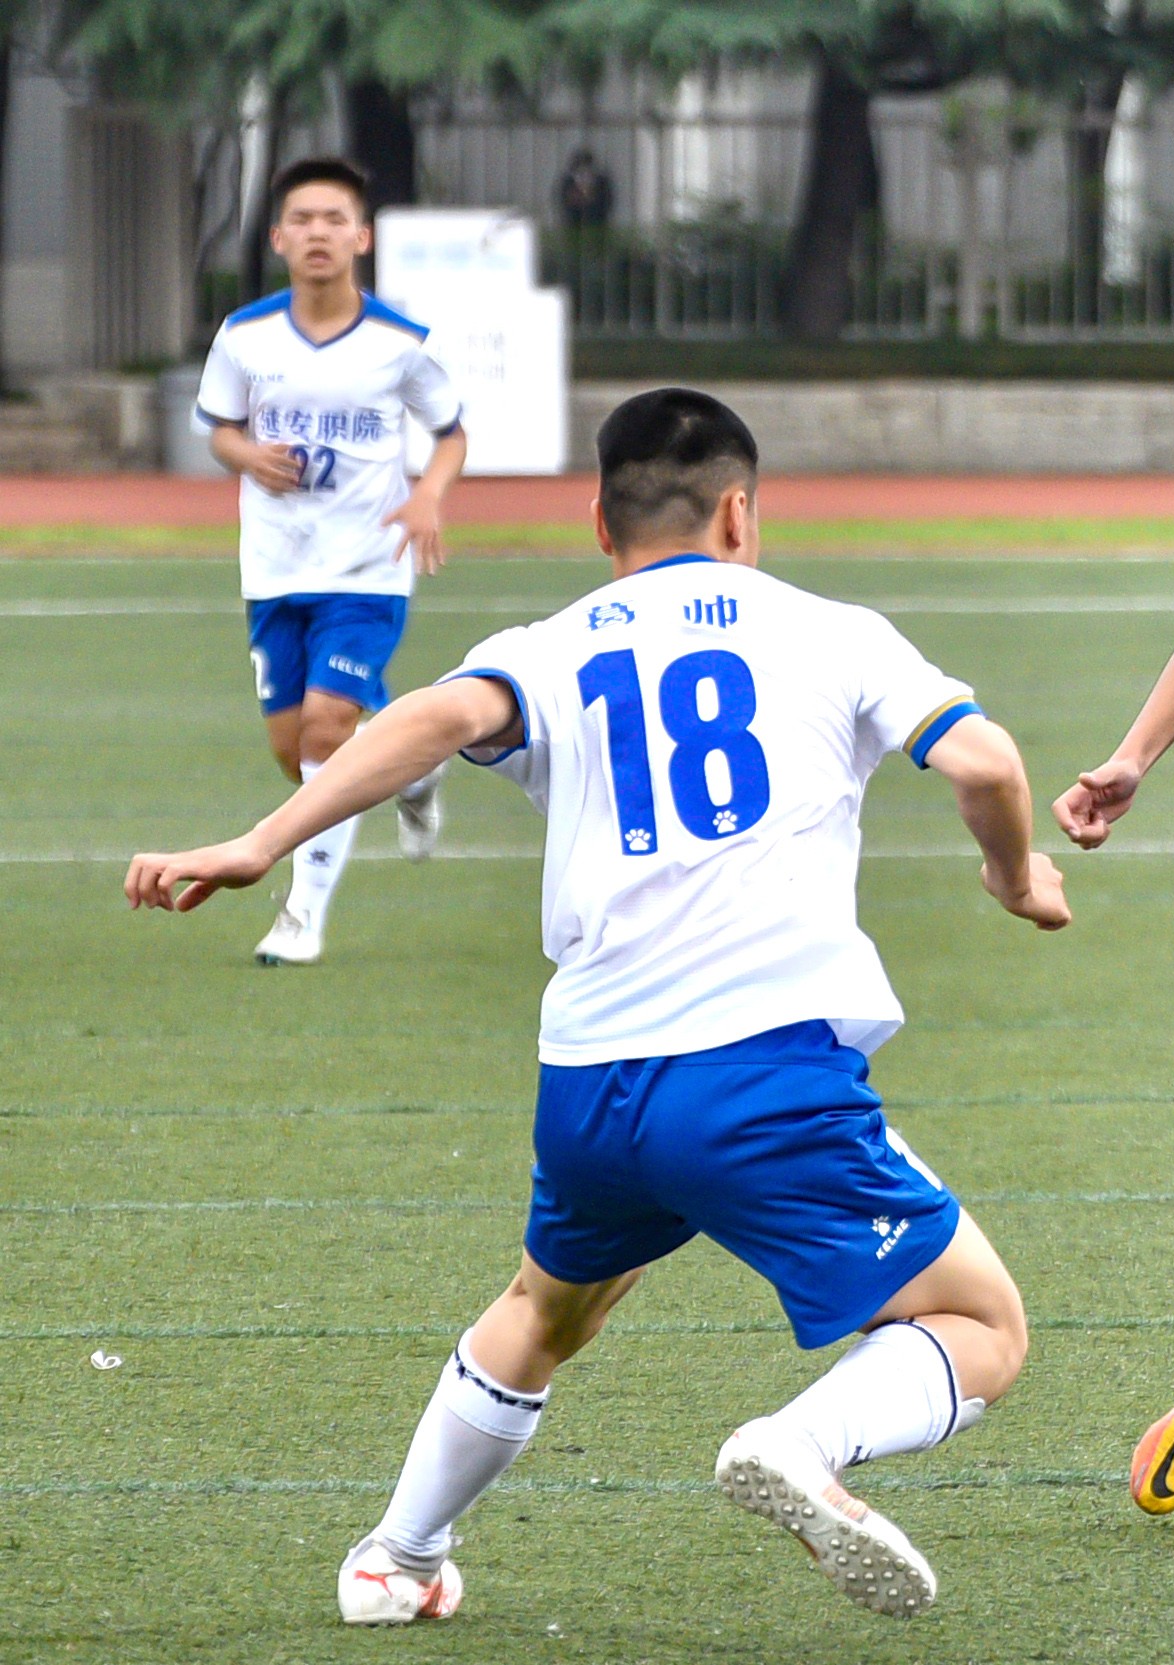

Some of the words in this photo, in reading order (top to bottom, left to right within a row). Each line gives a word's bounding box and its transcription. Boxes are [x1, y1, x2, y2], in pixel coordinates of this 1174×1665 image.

[288, 444, 336, 491] 22
[576, 648, 770, 857] 18
[876, 1218, 911, 1260] KELME
